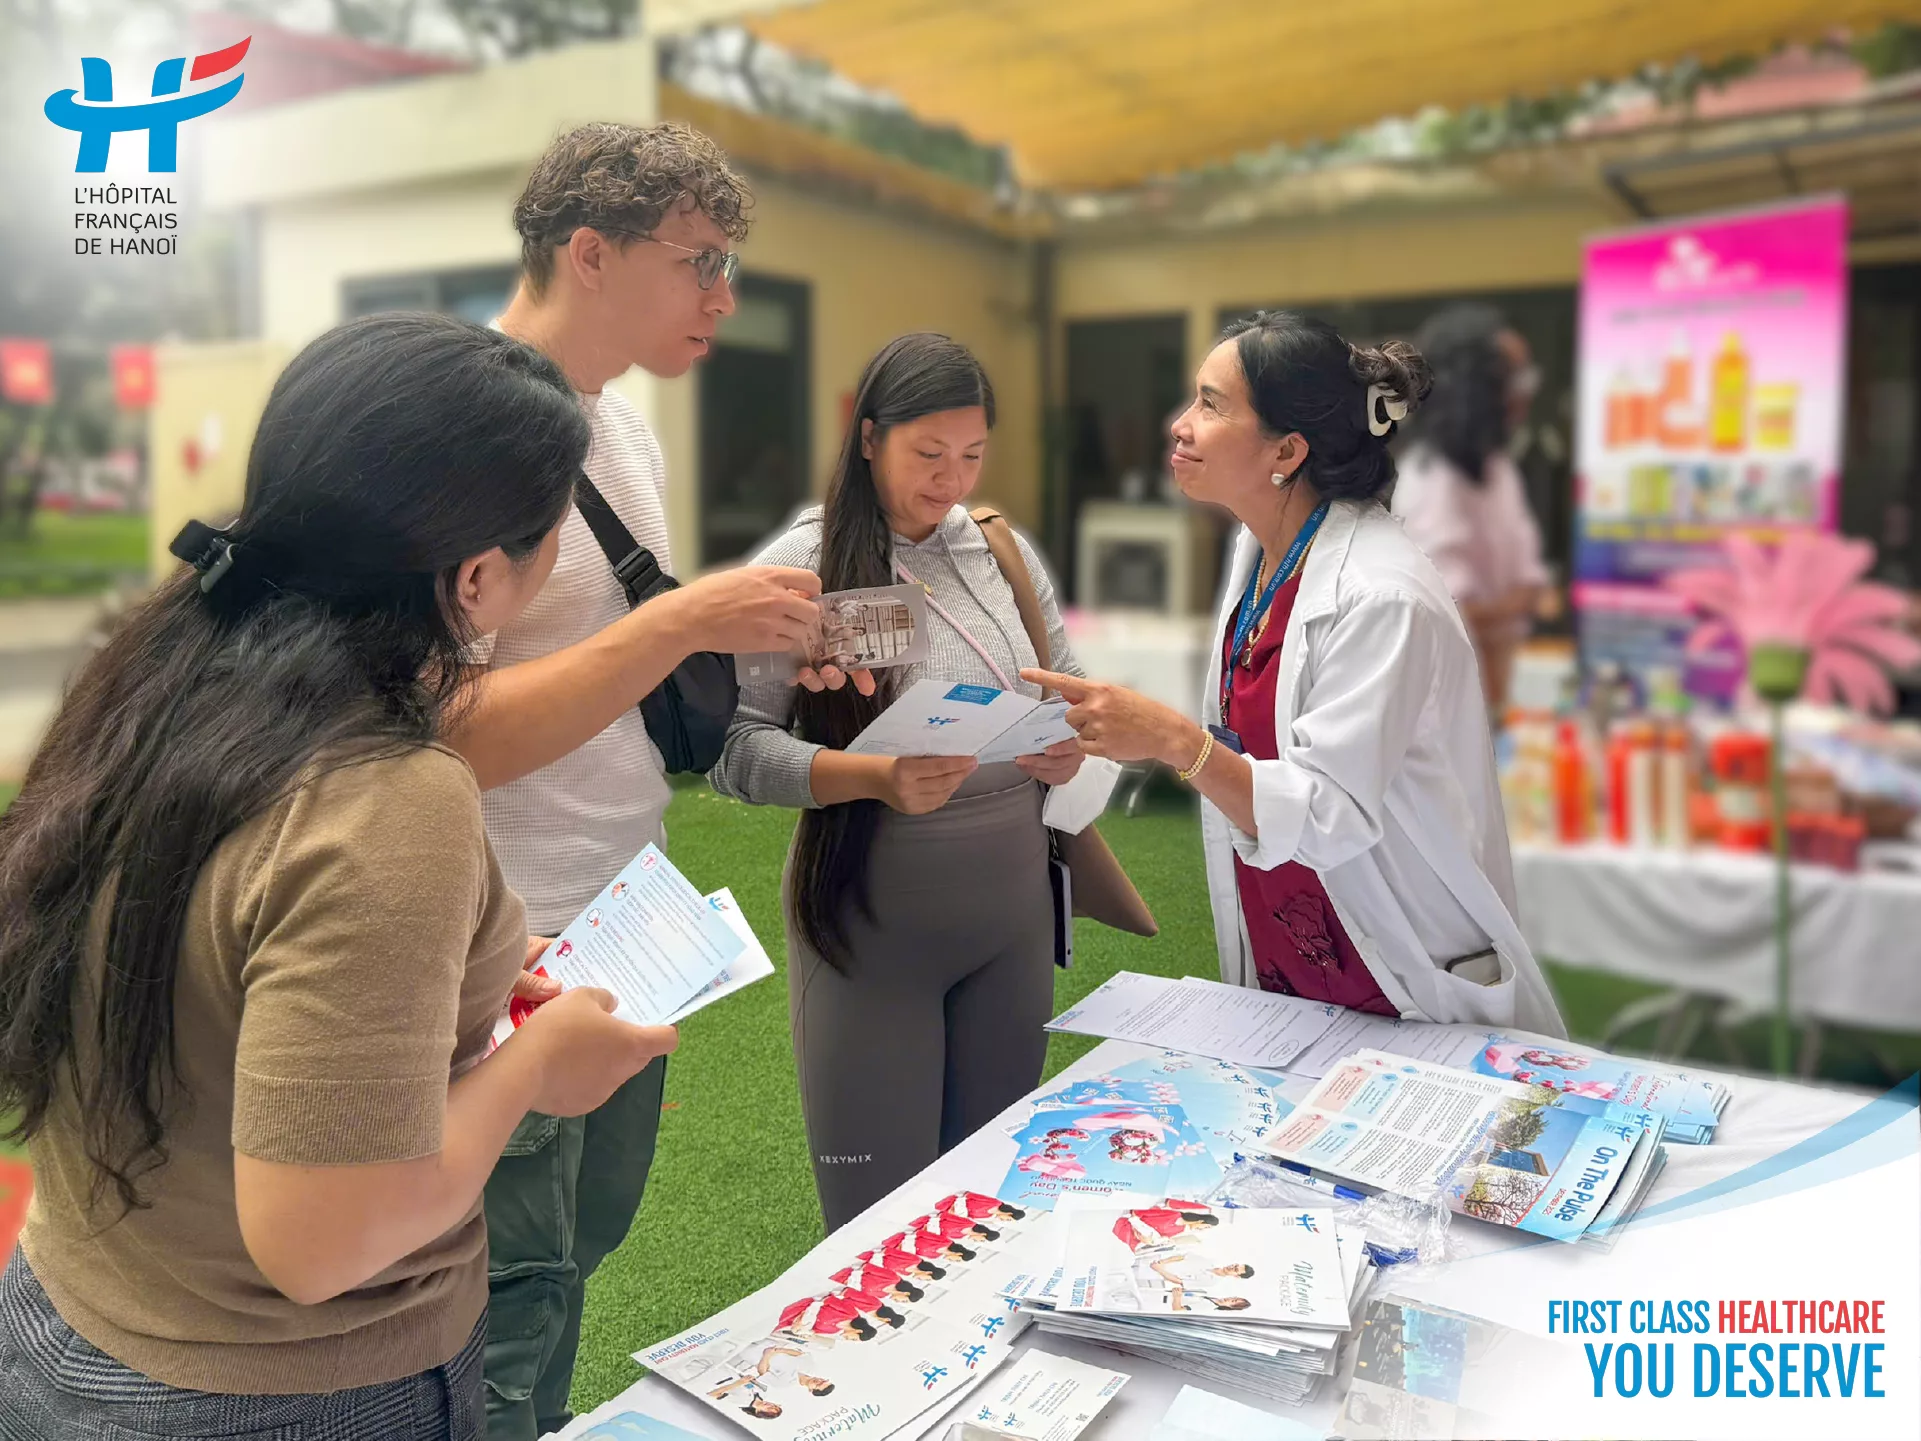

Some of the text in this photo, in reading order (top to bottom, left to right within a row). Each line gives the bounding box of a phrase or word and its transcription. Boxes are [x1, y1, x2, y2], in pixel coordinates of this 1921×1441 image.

[1554, 1147, 1618, 1222] On The Pulse
[1279, 1274, 1291, 1306] PACKAGE
[1288, 1261, 1315, 1315] Maternity
[644, 1332, 706, 1361] YOU DESERVE
[796, 1406, 848, 1436] PACKAGE
